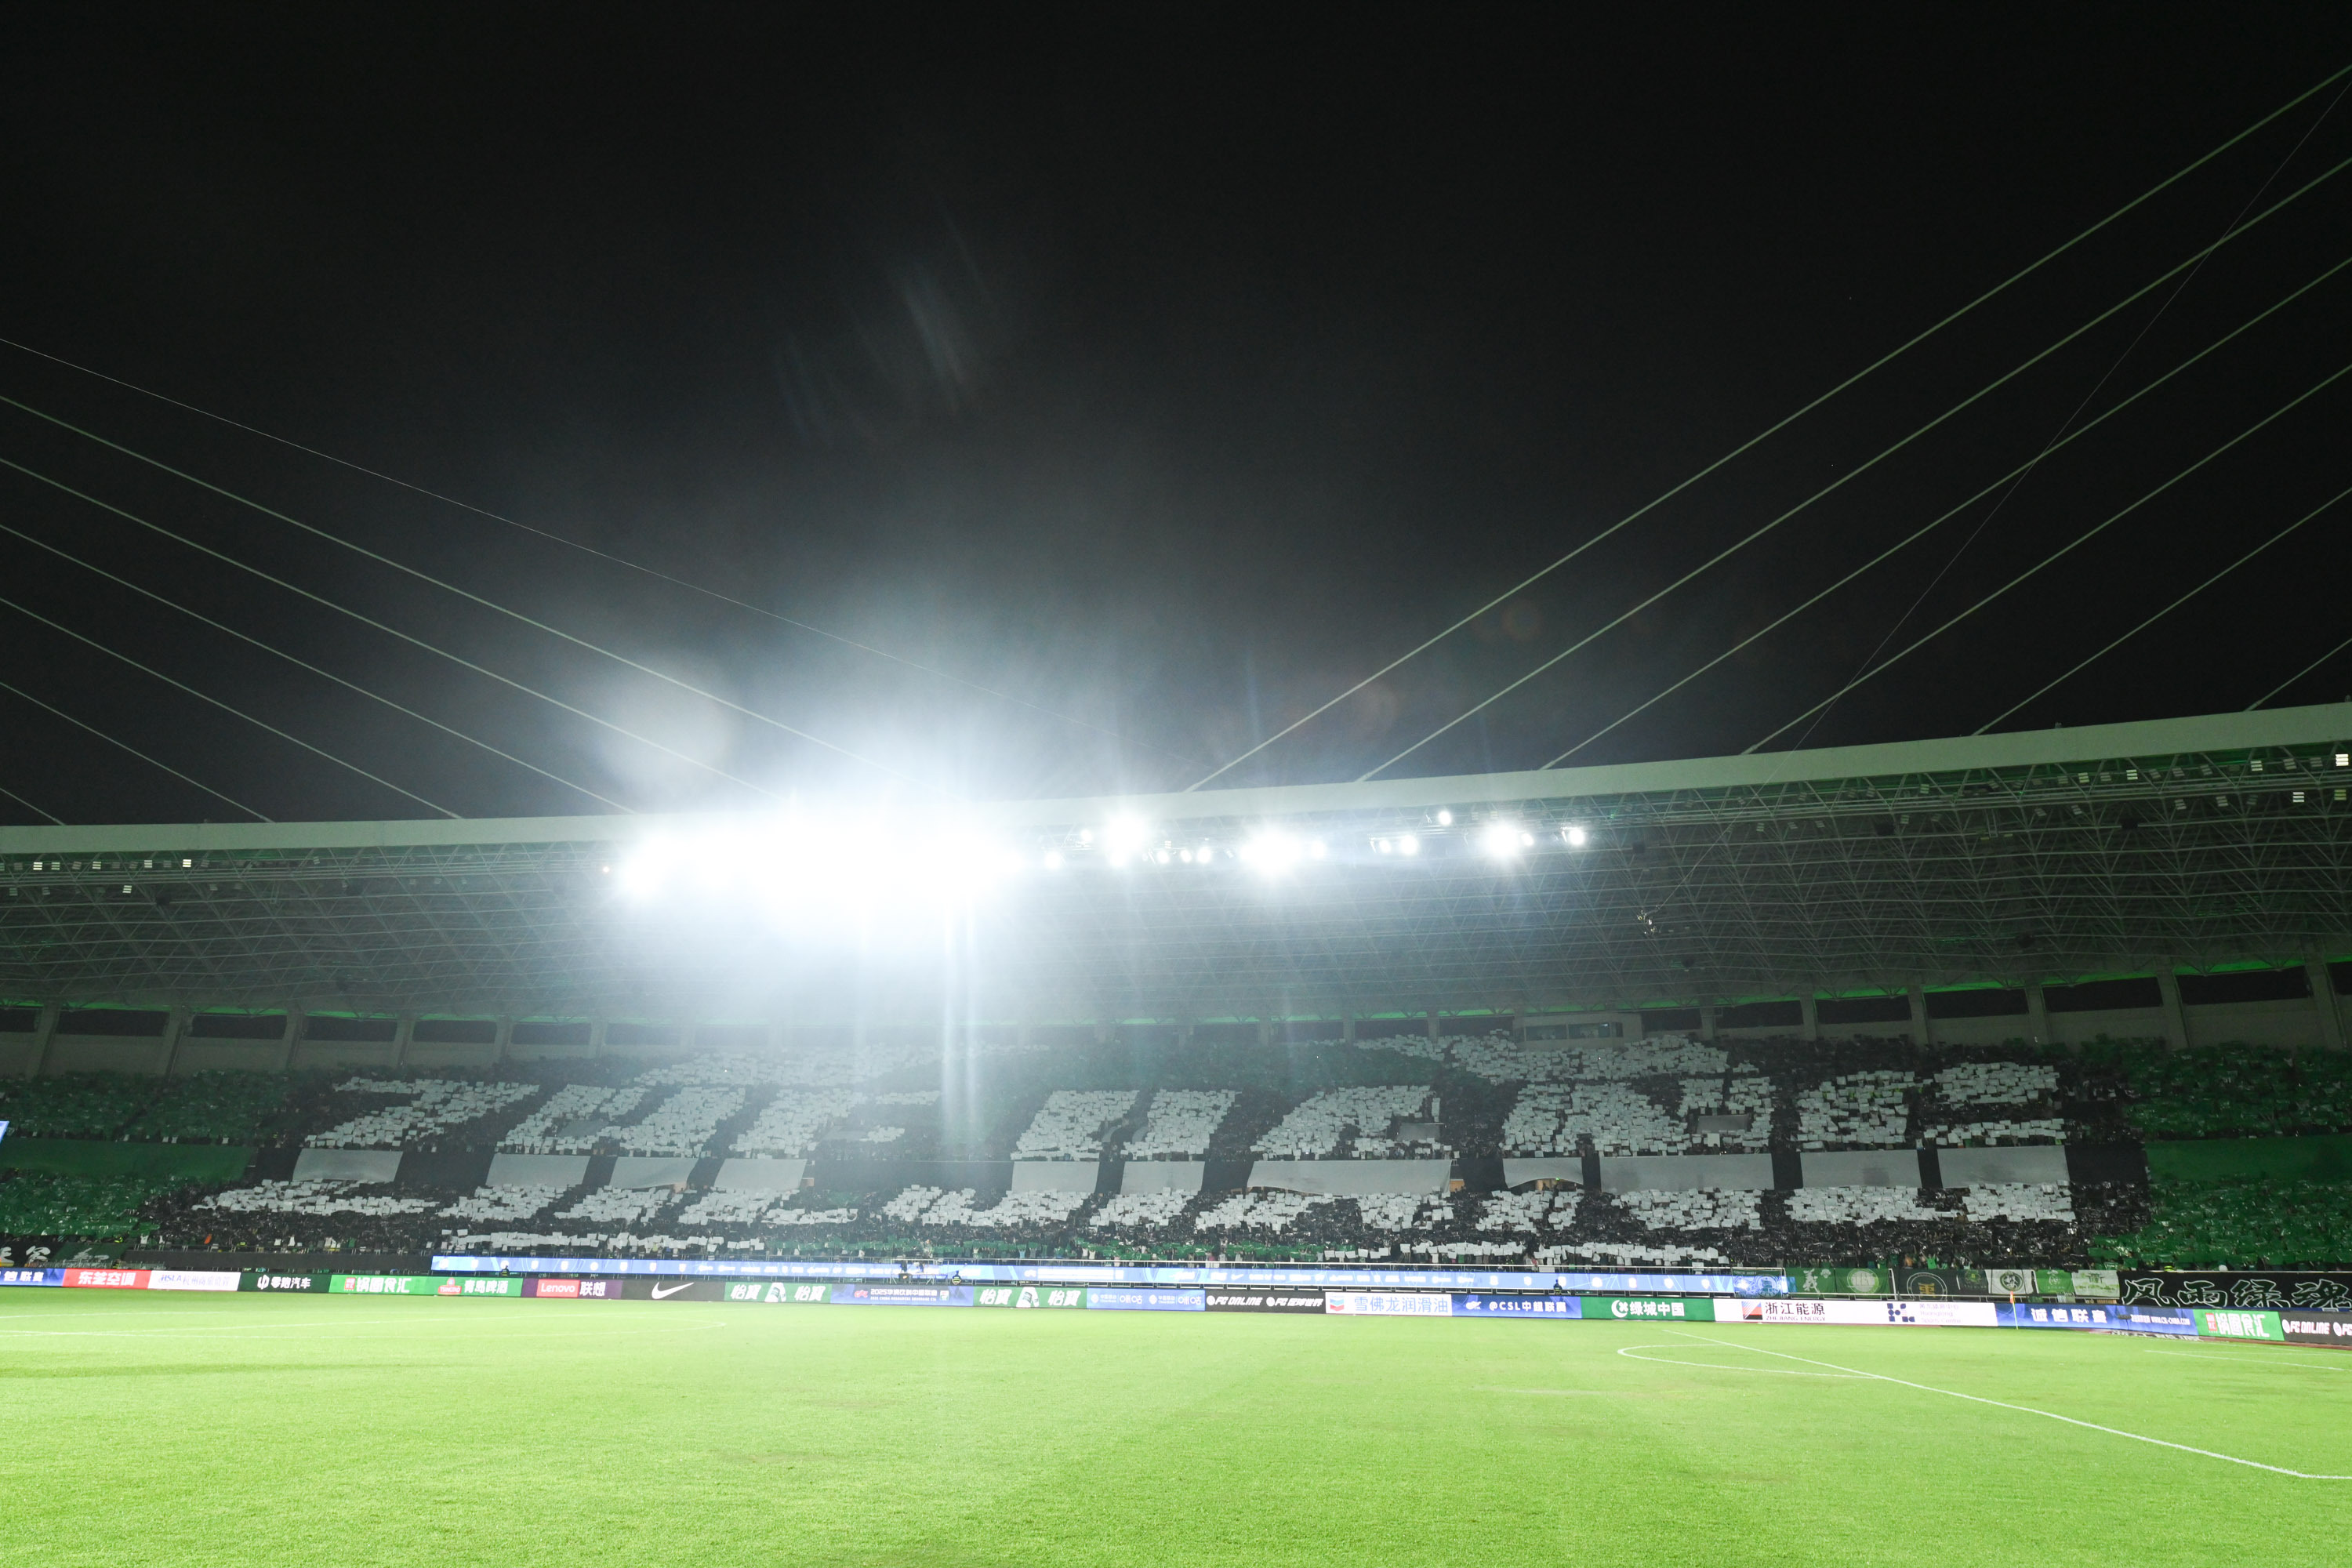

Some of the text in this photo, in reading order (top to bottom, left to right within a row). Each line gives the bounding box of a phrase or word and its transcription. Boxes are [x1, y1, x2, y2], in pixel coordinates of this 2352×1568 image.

[0, 1271, 44, 1282] 信联赛
[78, 1271, 136, 1286] 东芝空调
[270, 1276, 311, 1290] 零跑汽车
[356, 1276, 412, 1294] 锅圈食汇
[464, 1279, 508, 1294] 青岛啤酒
[541, 1283, 575, 1294] Lenovo
[579, 1281, 607, 1296] 联想
[1119, 1294, 1142, 1305] 咪咕
[1178, 1296, 1201, 1305] 咪咕
[1215, 1296, 1263, 1306] FC ONLINE
[1275, 1298, 1288, 1306] FC
[1355, 1296, 1448, 1313] 雪佛龙润滑油
[1630, 1301, 1685, 1316] 绿城中国
[1766, 1301, 1825, 1315] 浙江能源
[2031, 1308, 2107, 1323] 诚信联赛
[2215, 1312, 2270, 1338] 锅圈食汇
[2290, 1320, 2331, 1334] FC ONLINE
